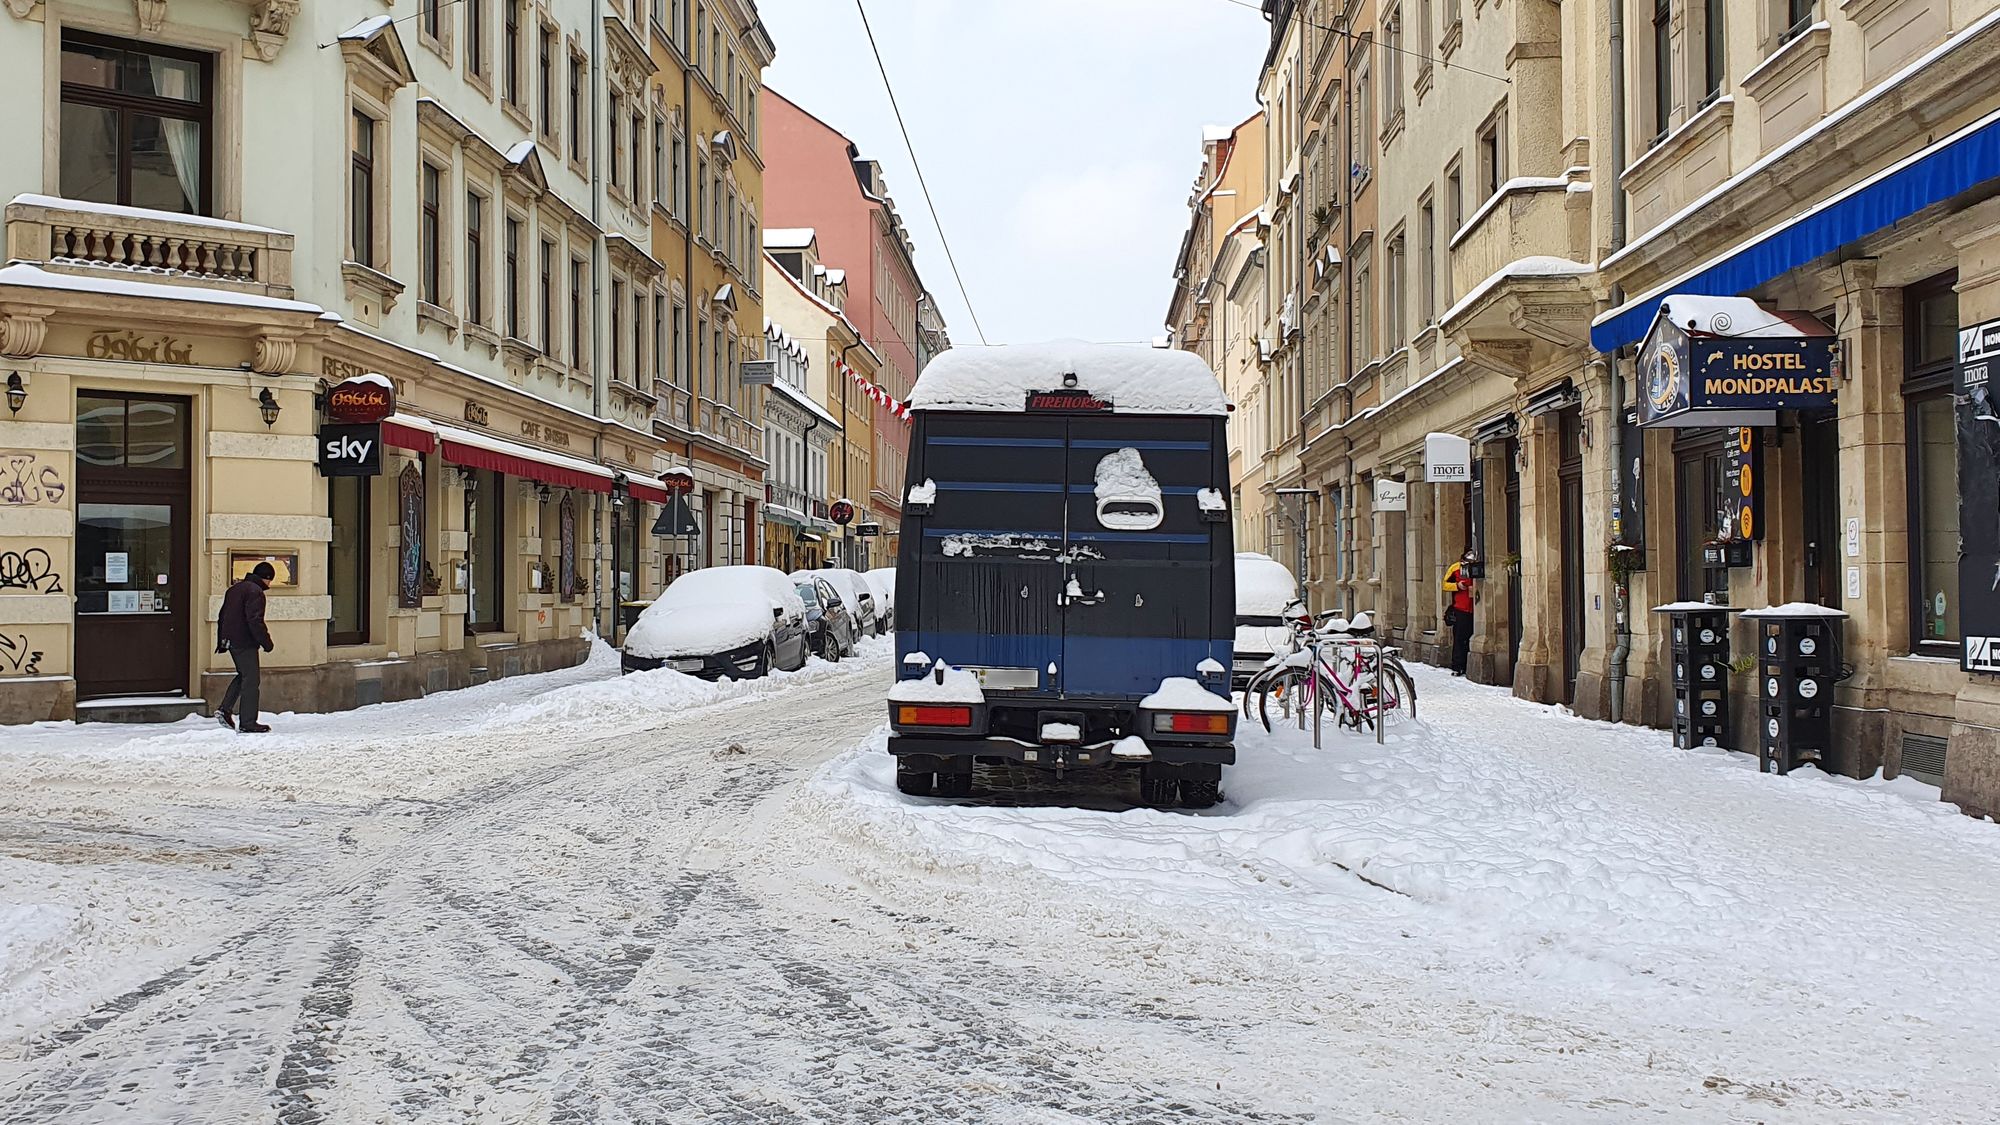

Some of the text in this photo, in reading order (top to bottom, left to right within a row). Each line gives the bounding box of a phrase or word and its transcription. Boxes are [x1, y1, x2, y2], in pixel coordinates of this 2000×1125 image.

[1733, 353, 1806, 370] HOSTEL
[1964, 365, 1989, 384] mora
[1705, 377, 1837, 395] MONDPALAST
[327, 435, 373, 463] sky
[1433, 466, 1465, 475] mora
